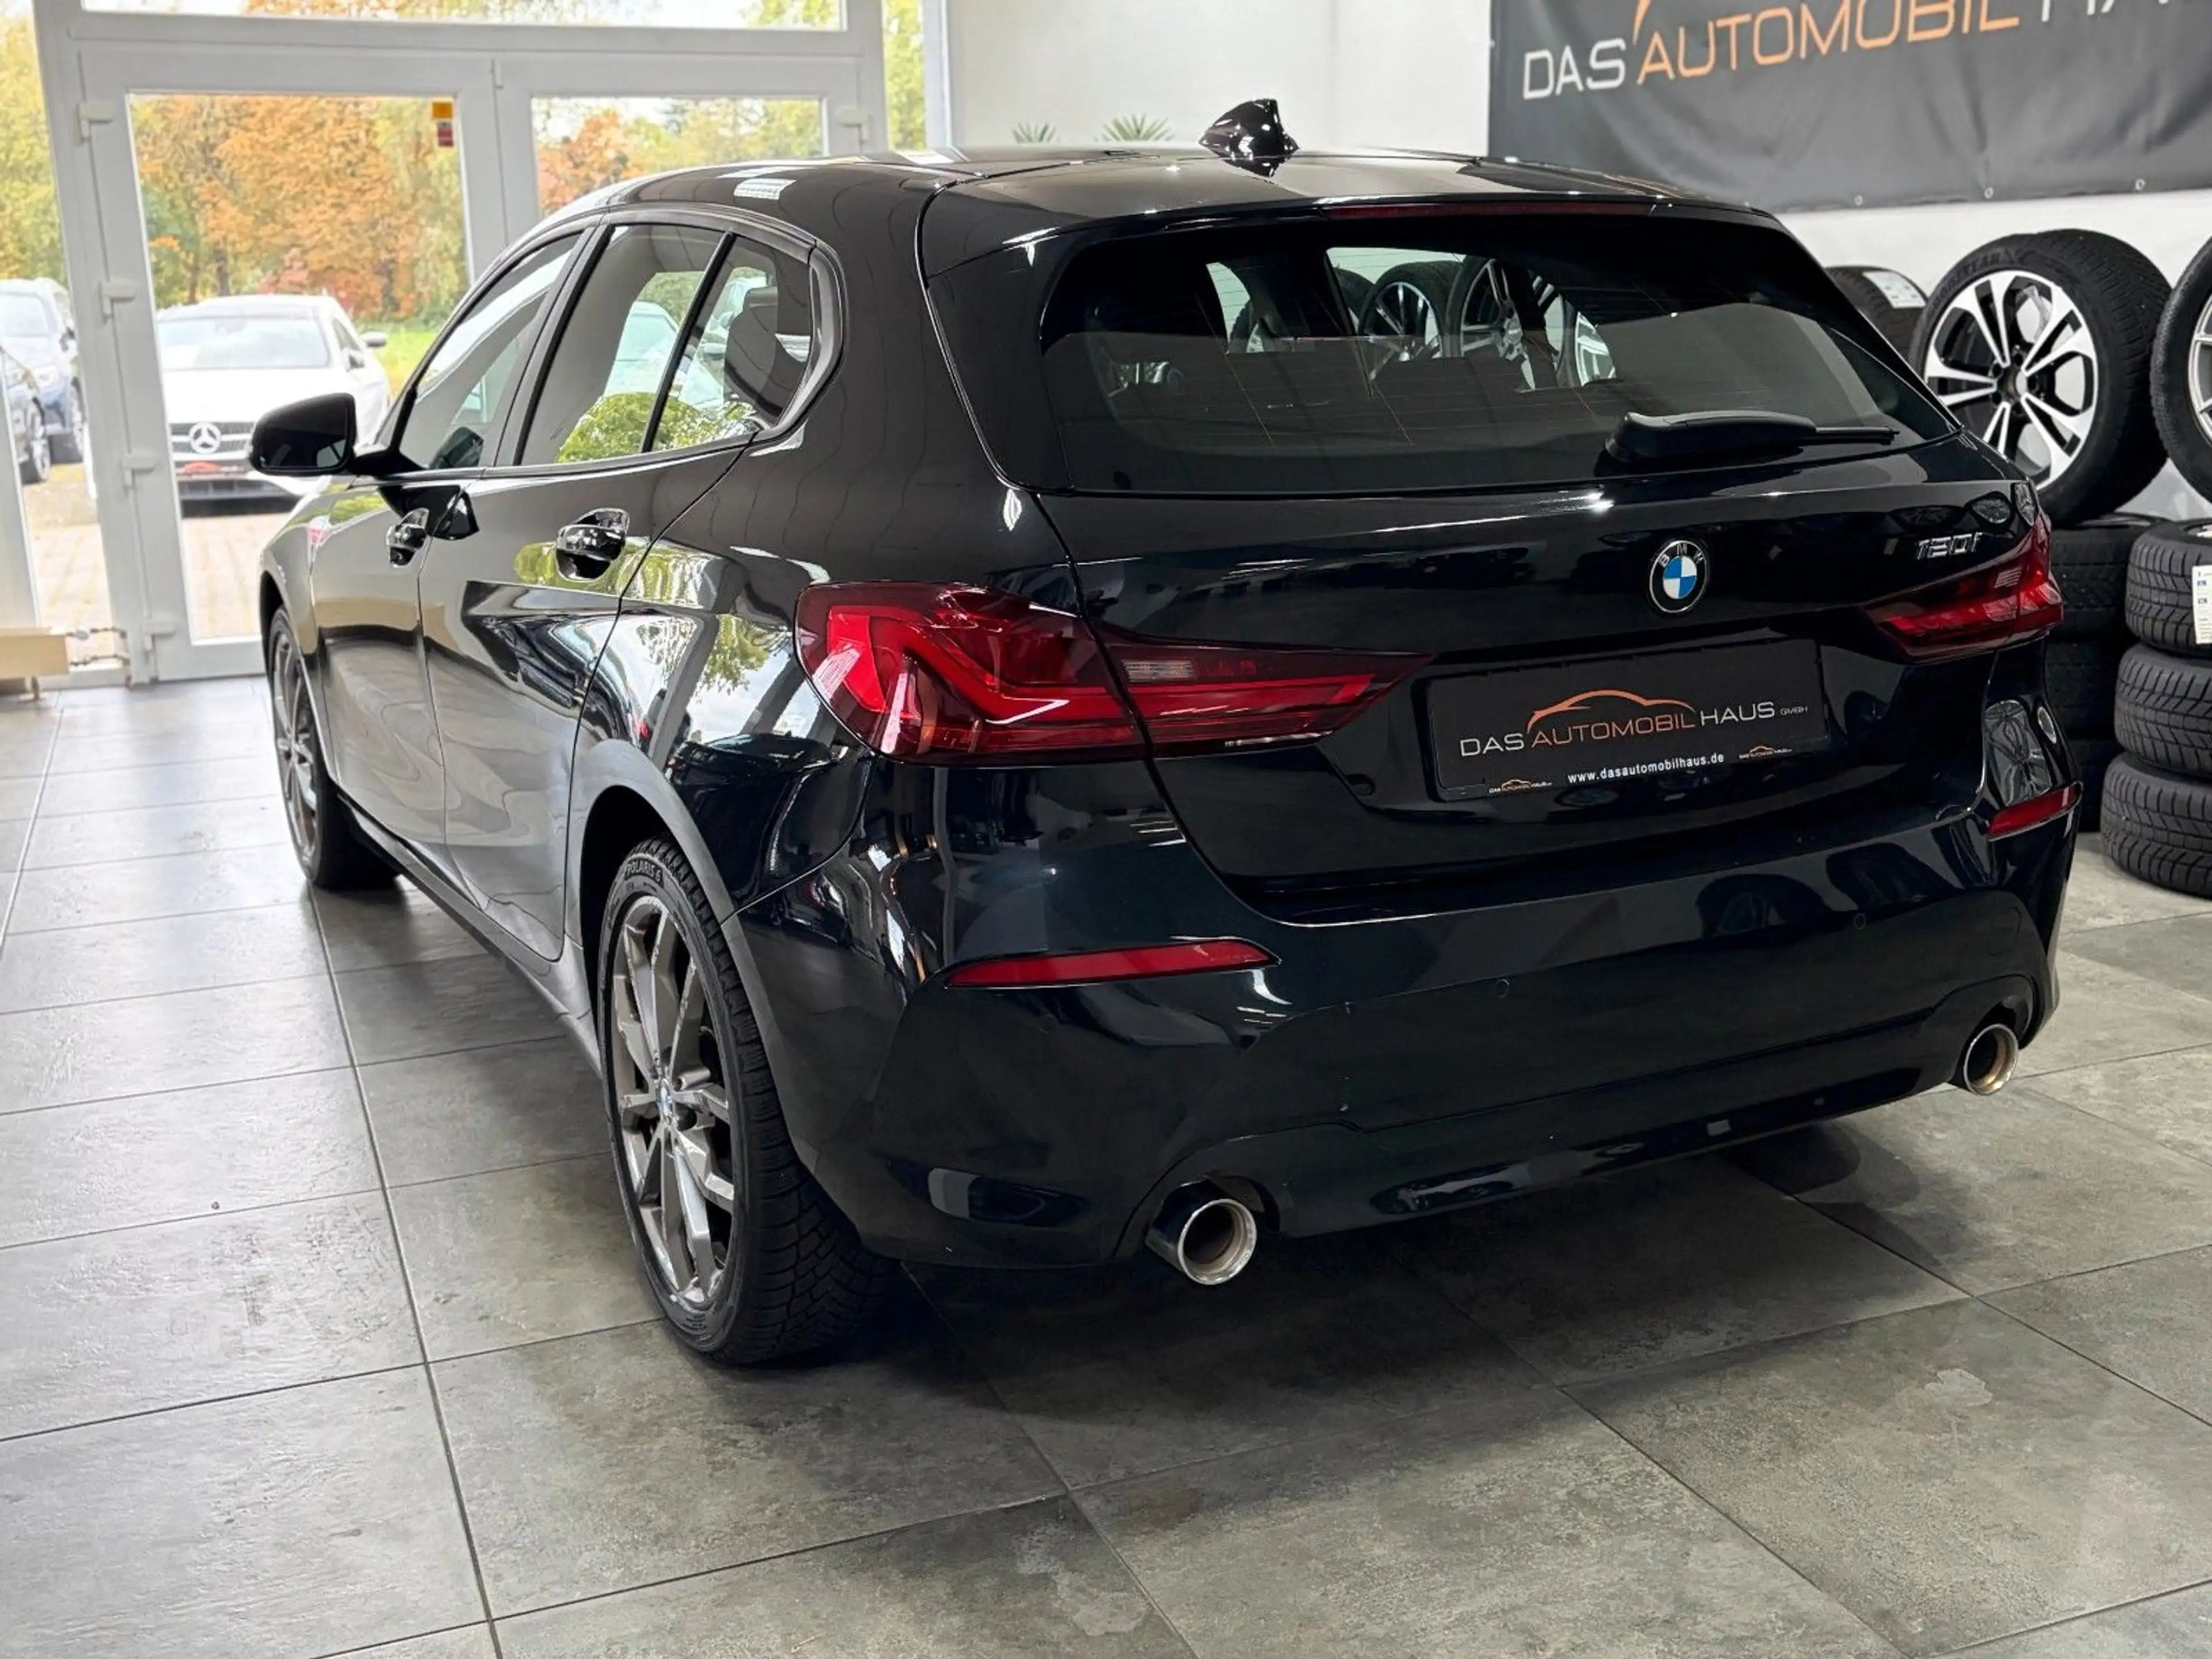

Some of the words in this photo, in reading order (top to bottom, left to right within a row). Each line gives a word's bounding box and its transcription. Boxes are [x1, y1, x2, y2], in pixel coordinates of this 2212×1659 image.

[1522, 37, 1626, 100] DAS
[1637, 0, 2020, 85] AUTOMOBIL
[1658, 542, 1704, 568] BMW
[1459, 733, 1525, 757] DAS
[1531, 713, 1696, 749] AUTOMOBIL
[1700, 701, 1775, 726] HAUS
[1567, 752, 1725, 784] www.dasautomobilhaus.de
